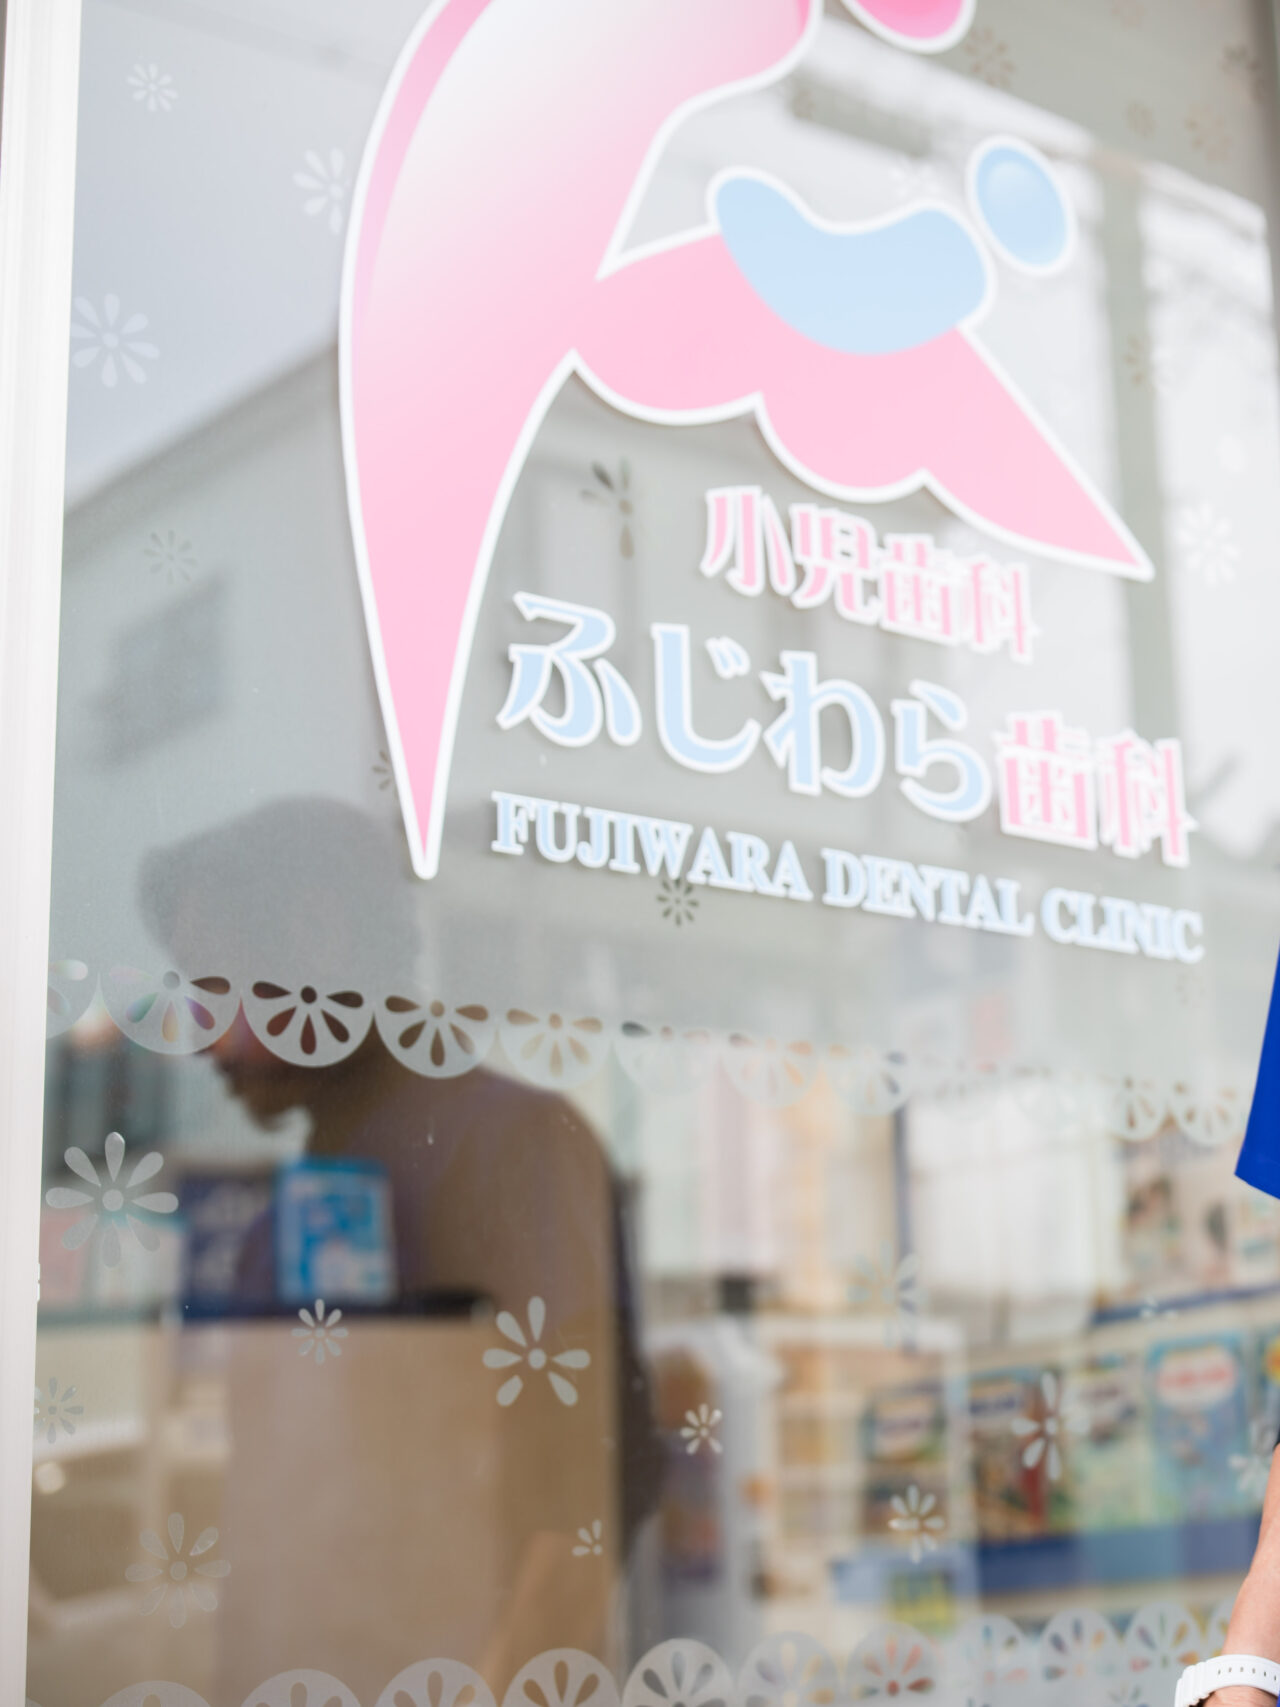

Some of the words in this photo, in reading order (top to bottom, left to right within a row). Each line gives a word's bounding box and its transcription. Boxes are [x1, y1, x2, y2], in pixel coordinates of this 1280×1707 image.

[701, 486, 1040, 661] 小児歯科
[496, 592, 1198, 867] ふじわら歯科
[491, 791, 812, 900] FUJIWARA
[822, 848, 1034, 936] DENTAL
[1041, 888, 1204, 963] CLINIC
